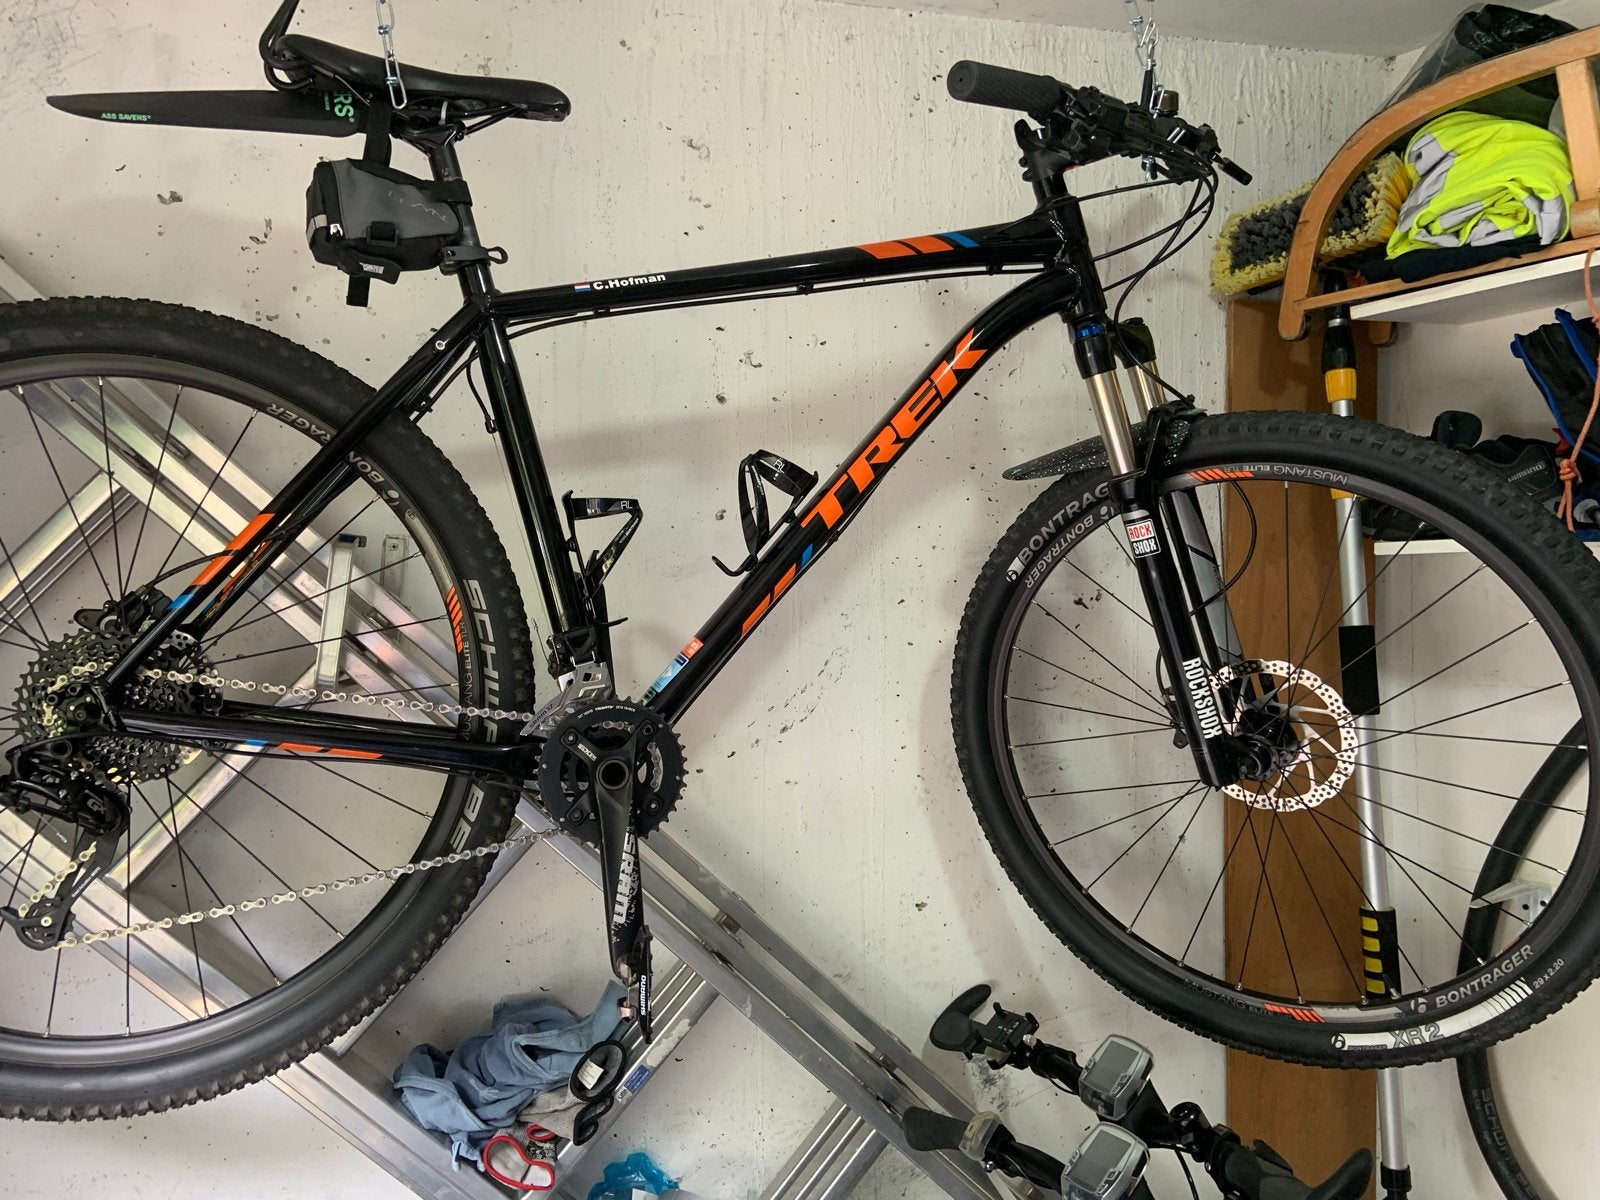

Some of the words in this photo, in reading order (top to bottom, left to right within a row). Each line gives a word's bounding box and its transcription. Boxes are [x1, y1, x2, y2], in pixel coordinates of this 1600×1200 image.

[592, 274, 666, 290] C.Hofman
[800, 327, 988, 529] TREK
[1274, 465, 1348, 485] MUSTANG
[1018, 482, 1109, 566] BONTRAG
[1128, 523, 1152, 540] ROCK
[1025, 514, 1094, 588] BONTRAGER
[1132, 538, 1157, 555] SHOX
[1182, 657, 1223, 739] ROCKSHOX
[1435, 944, 1535, 1009] BONTRAGER
[1532, 976, 1545, 989] 29
[1548, 958, 1565, 976] 2.20
[639, 974, 647, 1016] SHIMANO
